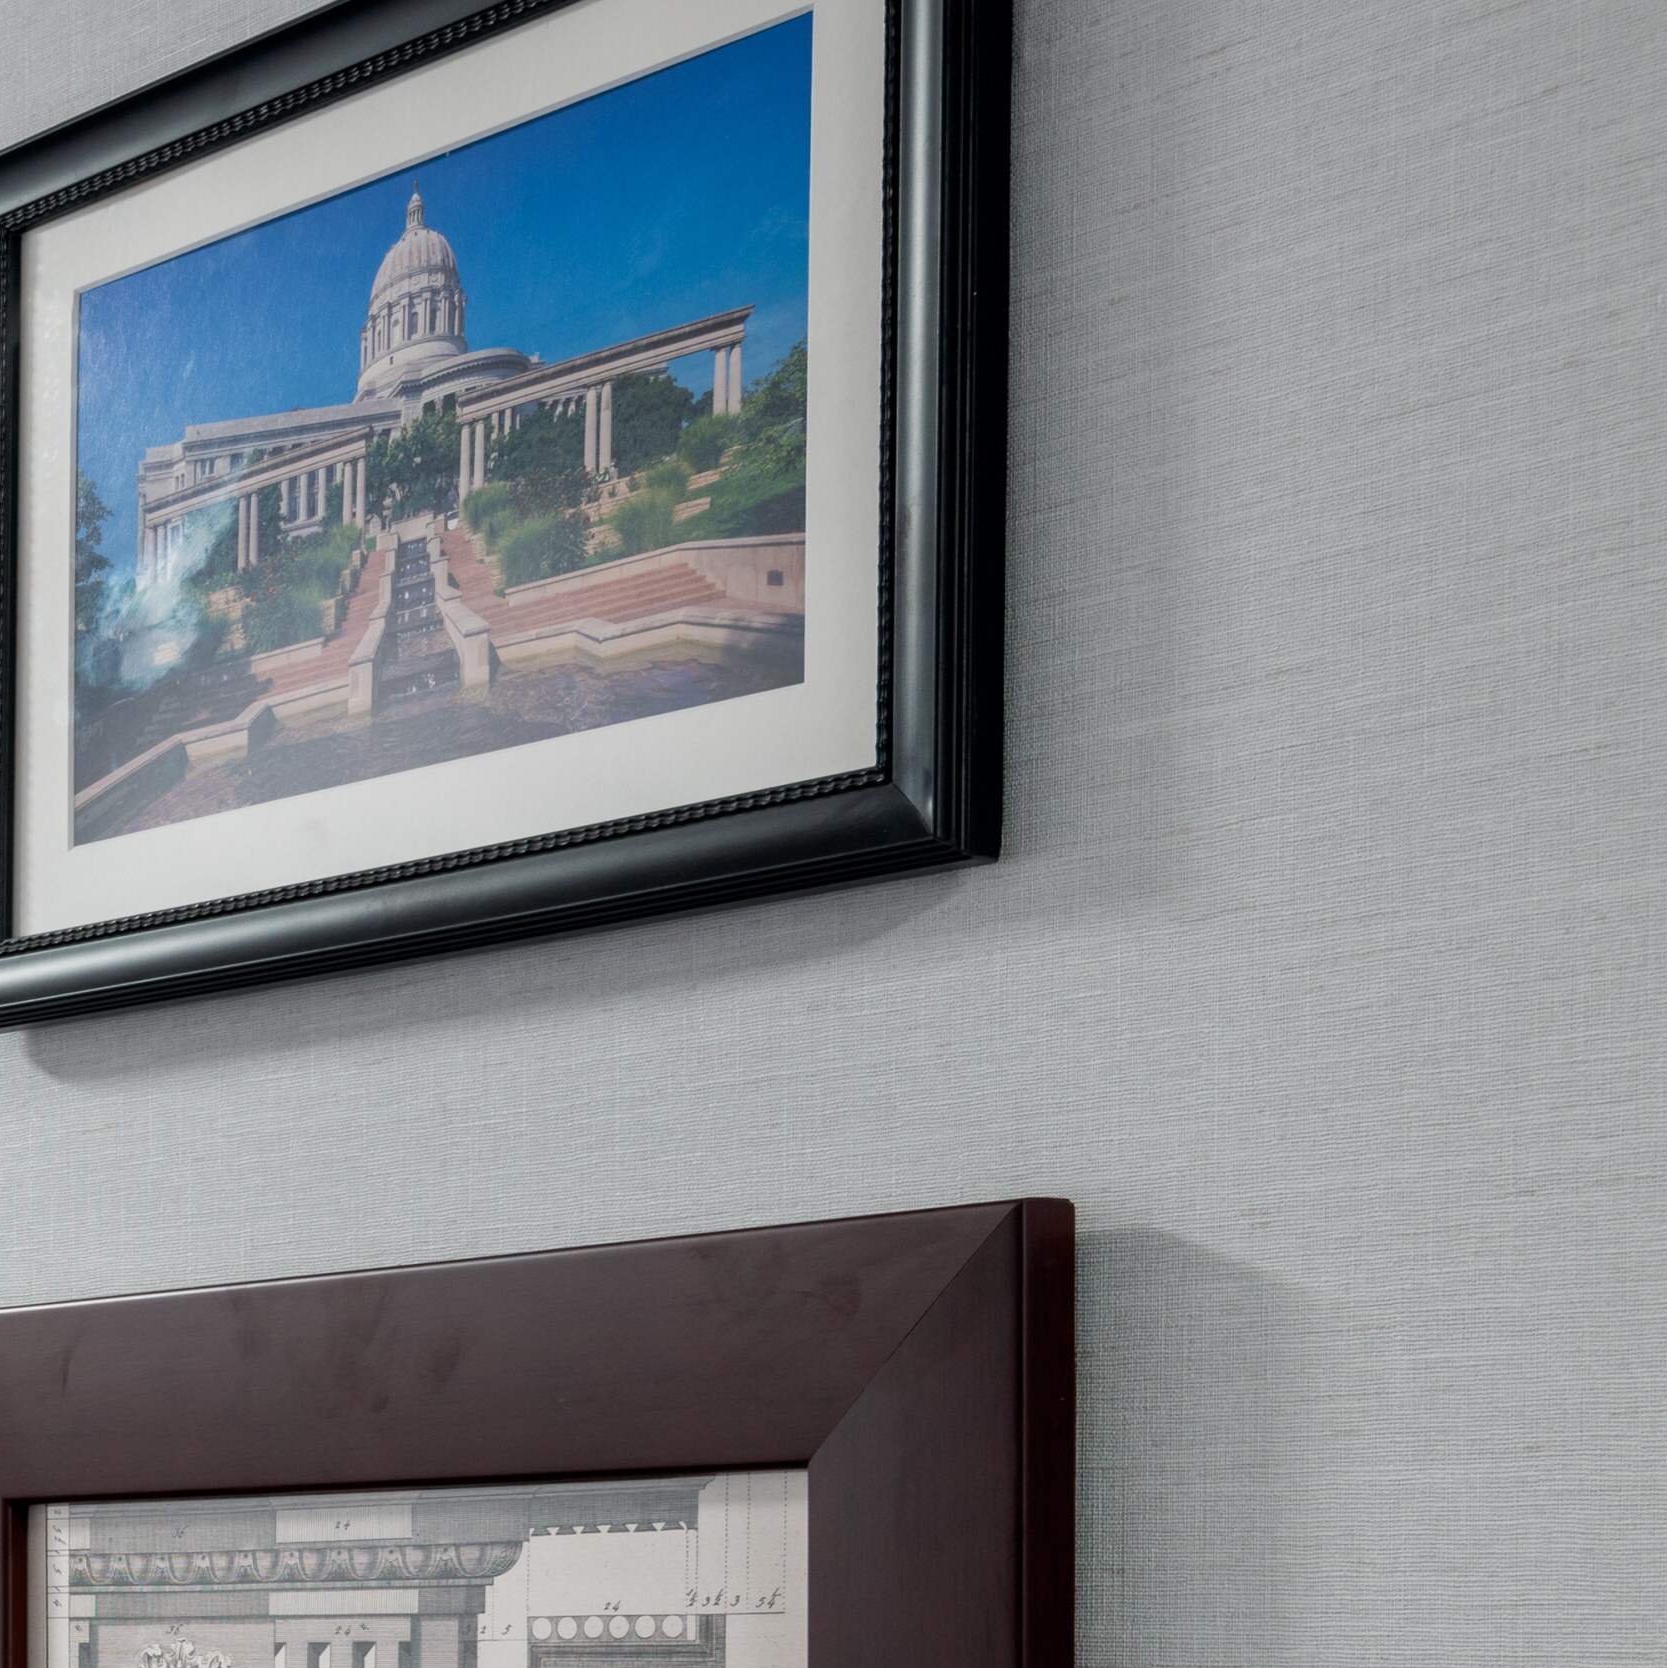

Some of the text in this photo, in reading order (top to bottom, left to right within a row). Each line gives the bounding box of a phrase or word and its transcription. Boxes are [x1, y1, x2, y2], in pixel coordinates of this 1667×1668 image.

[335, 1519, 351, 1531] 24
[603, 1600, 621, 1613] 24
[730, 1595, 741, 1607] 3
